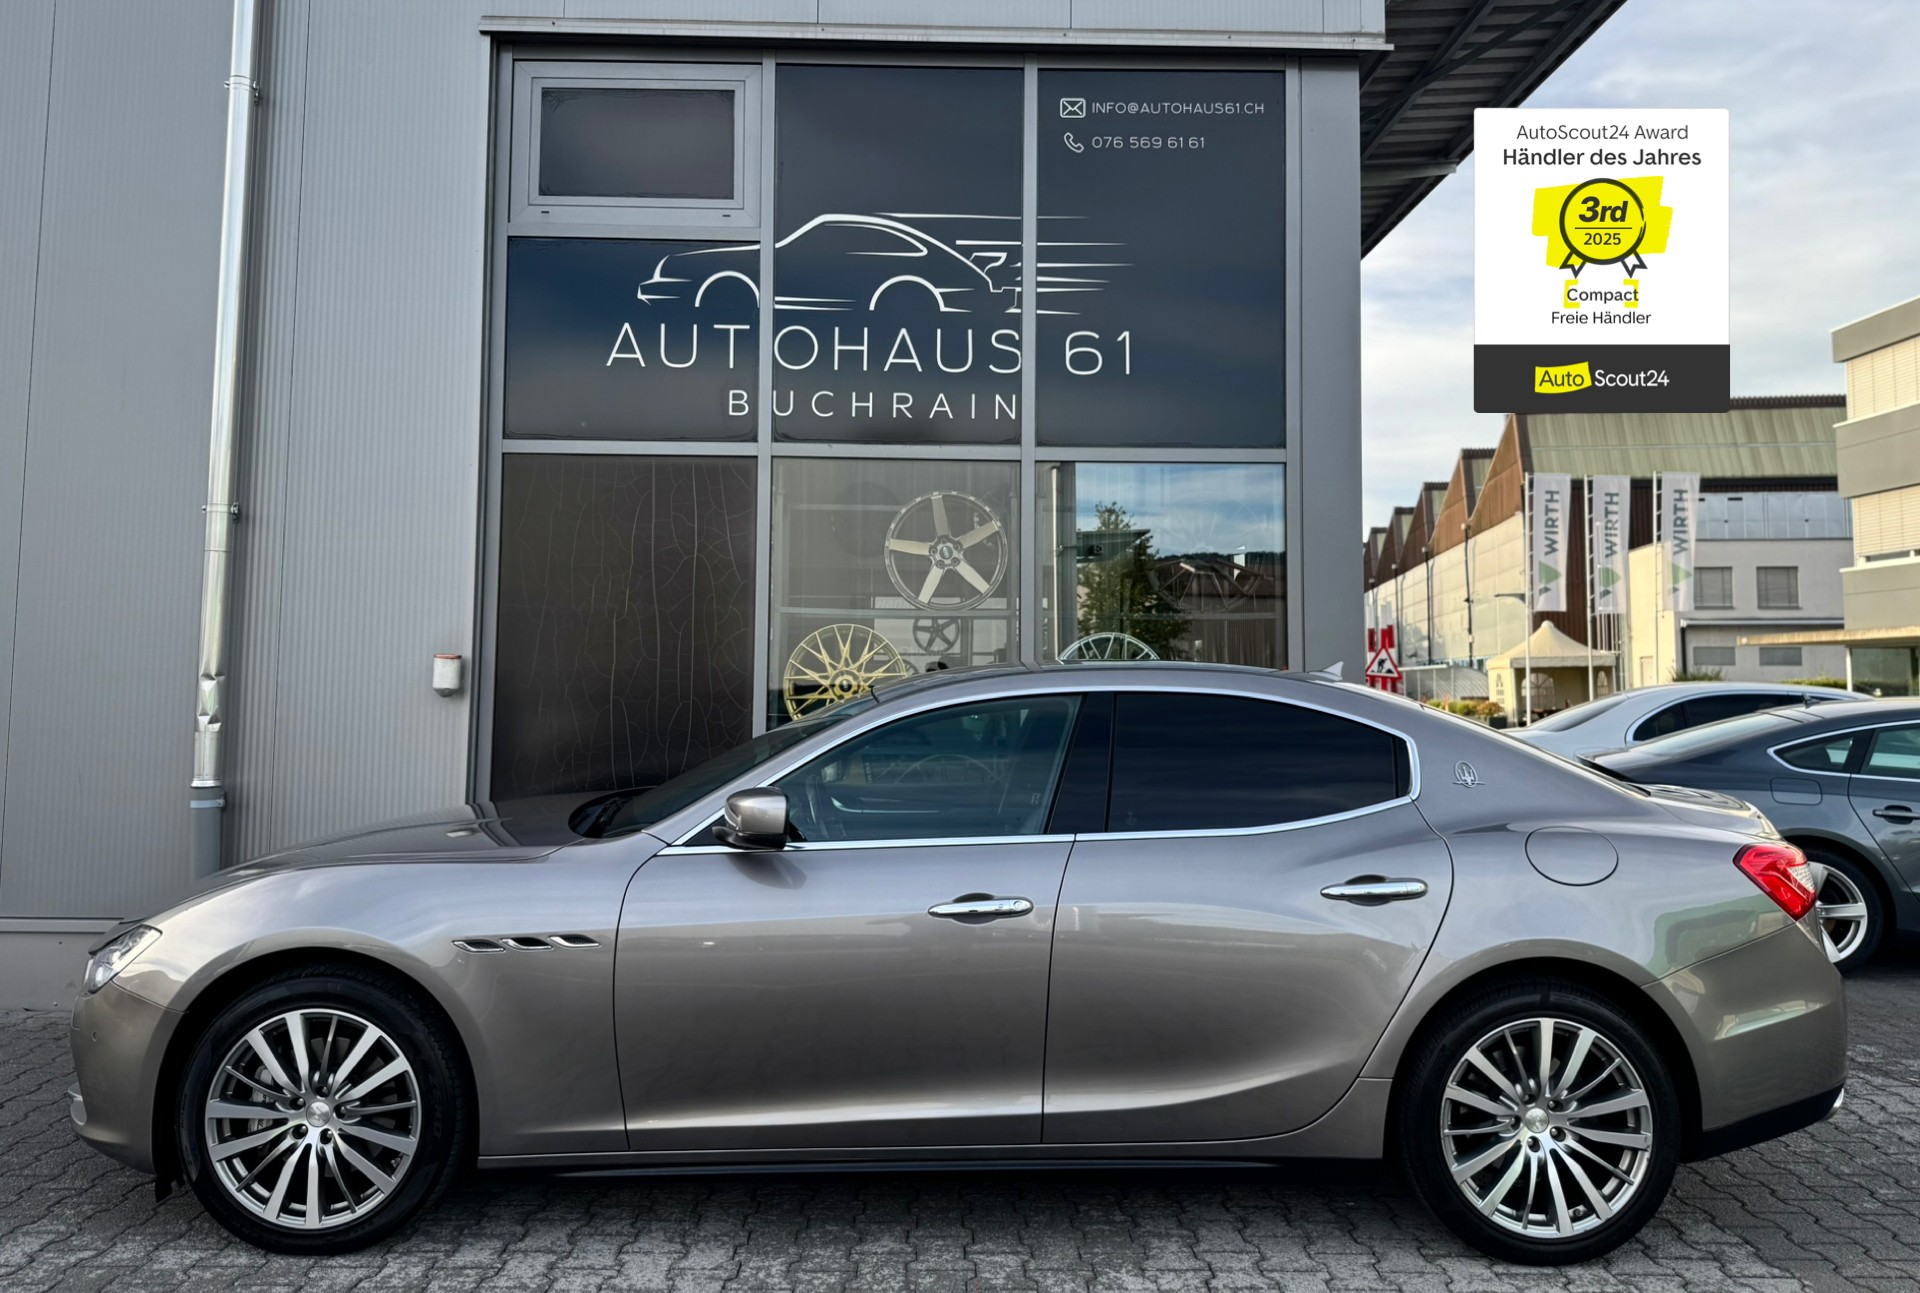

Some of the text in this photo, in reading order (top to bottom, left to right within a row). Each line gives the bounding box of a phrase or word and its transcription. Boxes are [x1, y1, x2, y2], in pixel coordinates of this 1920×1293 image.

[1091, 102, 1265, 115] INFO@AUTOHAUS61.CH
[1091, 136, 1205, 149] 076 569 61 61
[606, 322, 1131, 376] AUTOHAUS 61
[728, 389, 1017, 420] BUCHRAIN
[1544, 490, 1560, 556] WIRTH
[1604, 492, 1620, 559] WIRTH
[1672, 489, 1689, 556] WIRTH
